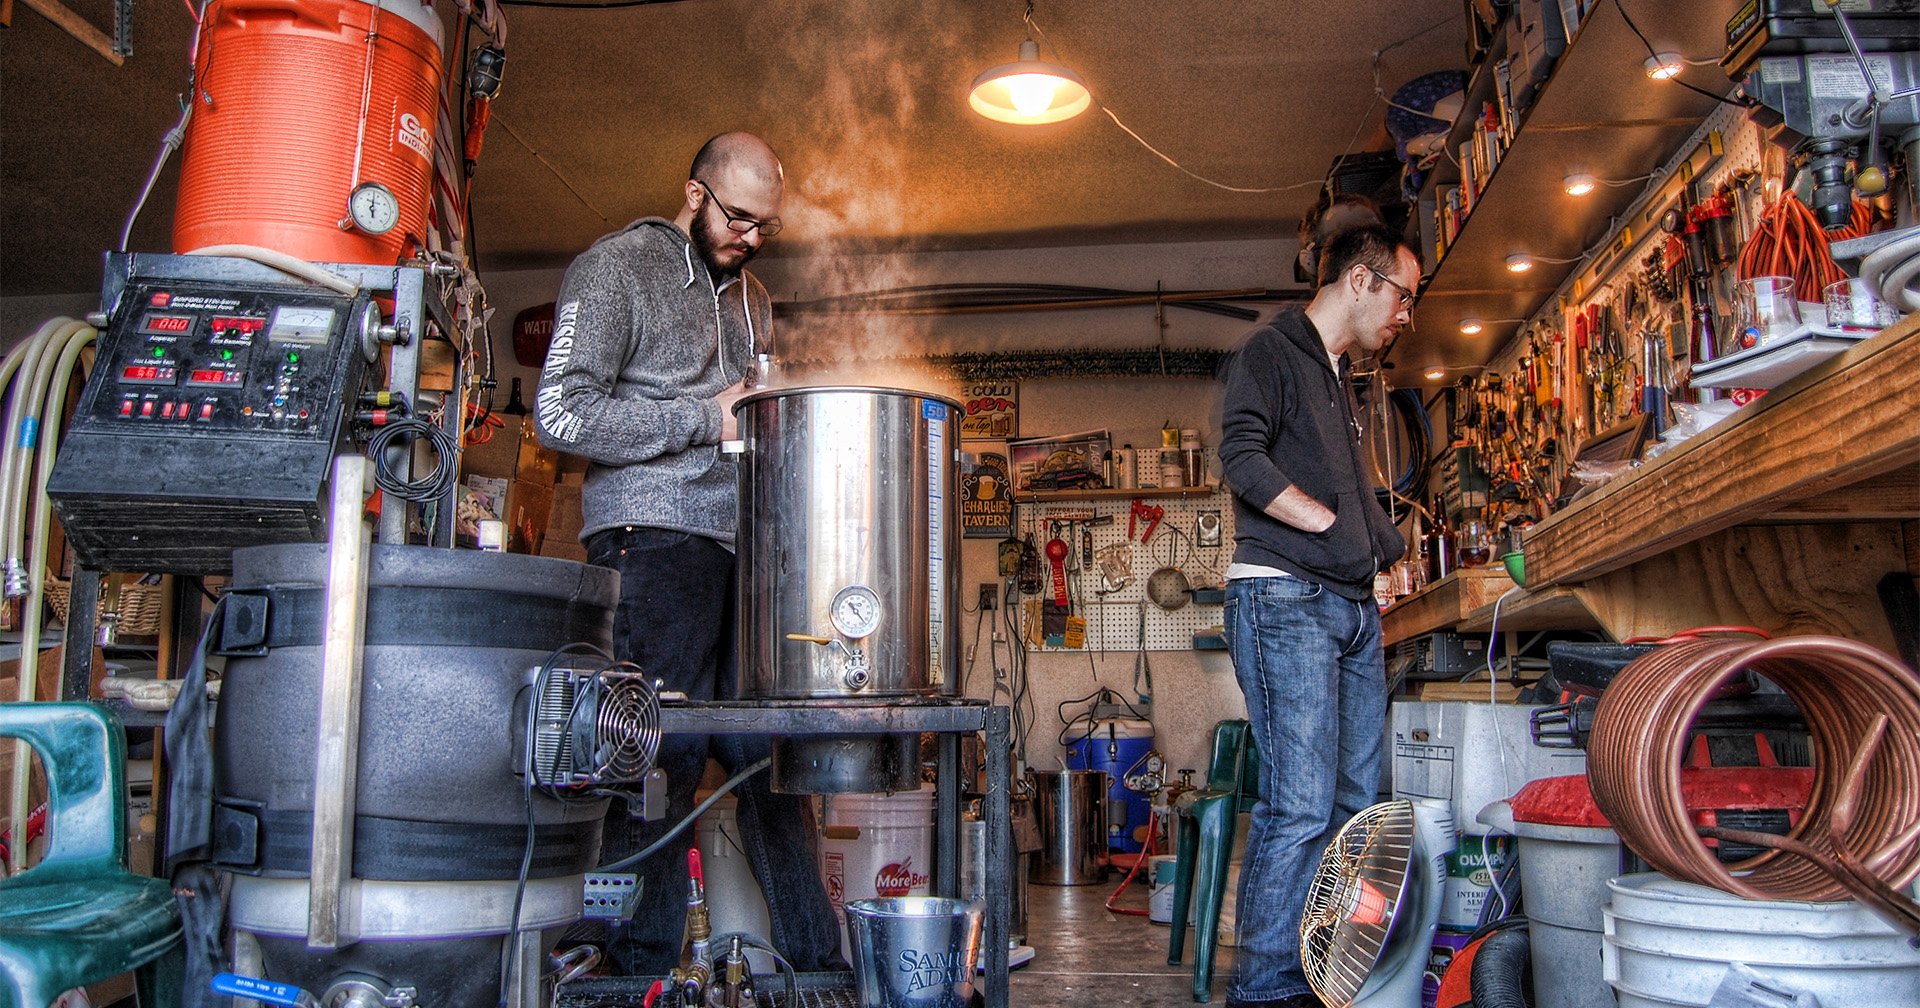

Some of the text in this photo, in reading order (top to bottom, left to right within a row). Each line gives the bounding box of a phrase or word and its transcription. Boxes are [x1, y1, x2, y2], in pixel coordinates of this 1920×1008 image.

[544, 301, 580, 380] RUSSIAN
[972, 385, 1012, 397] COLD
[537, 383, 574, 441] RIVER
[928, 405, 943, 417] 50
[964, 397, 1016, 416] eer
[963, 514, 1010, 527] TAVERN
[899, 947, 978, 973] SAMUE
